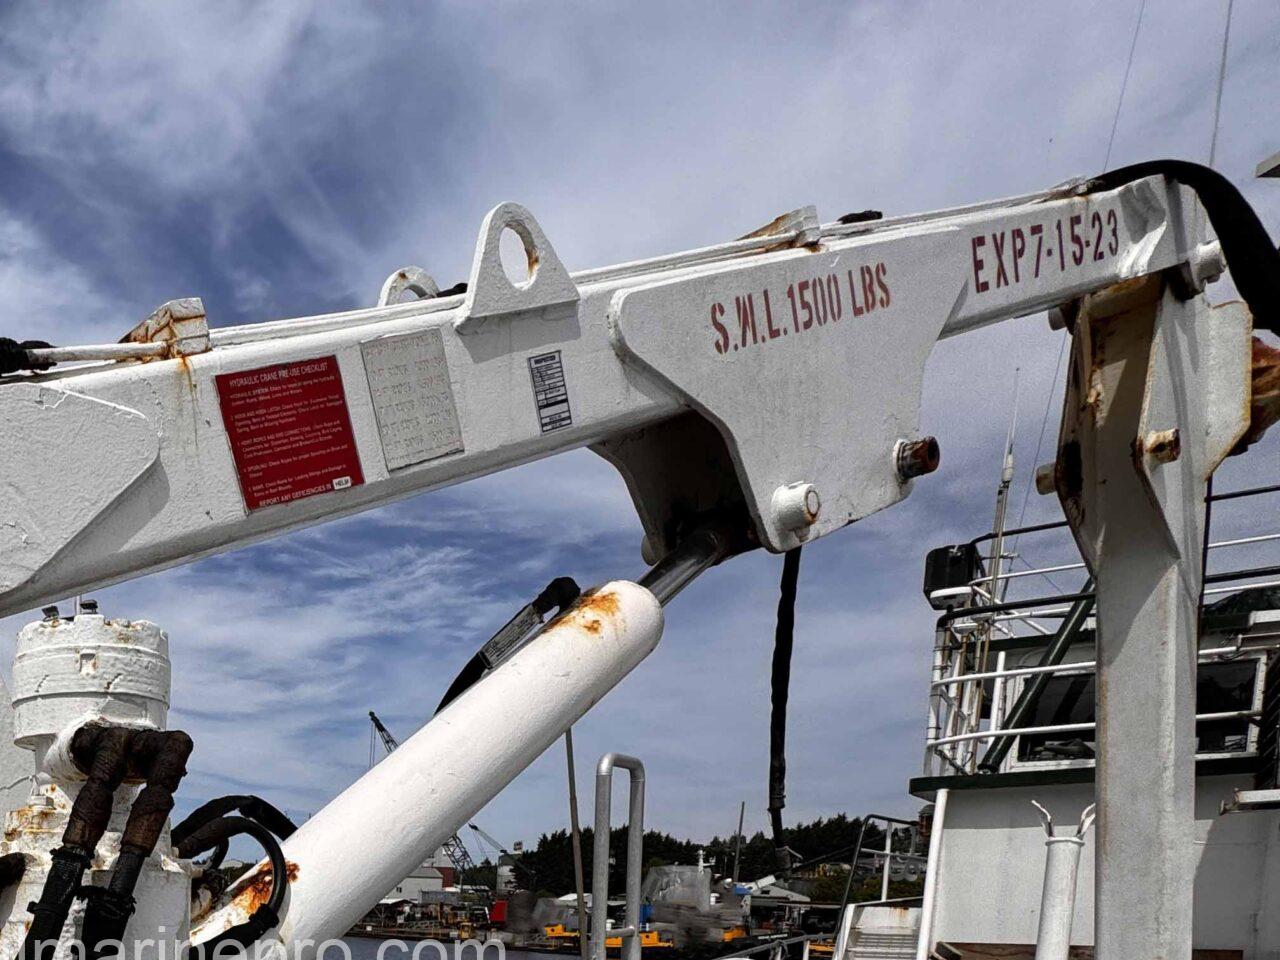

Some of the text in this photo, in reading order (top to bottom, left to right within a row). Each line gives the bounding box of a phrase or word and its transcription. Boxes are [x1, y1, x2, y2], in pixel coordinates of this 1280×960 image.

[787, 270, 842, 335] 1500
[848, 262, 891, 317] LBS
[228, 374, 260, 388] HYDRAULIC
[258, 371, 278, 382] CRANE
[300, 361, 329, 375] CHECKLIST
